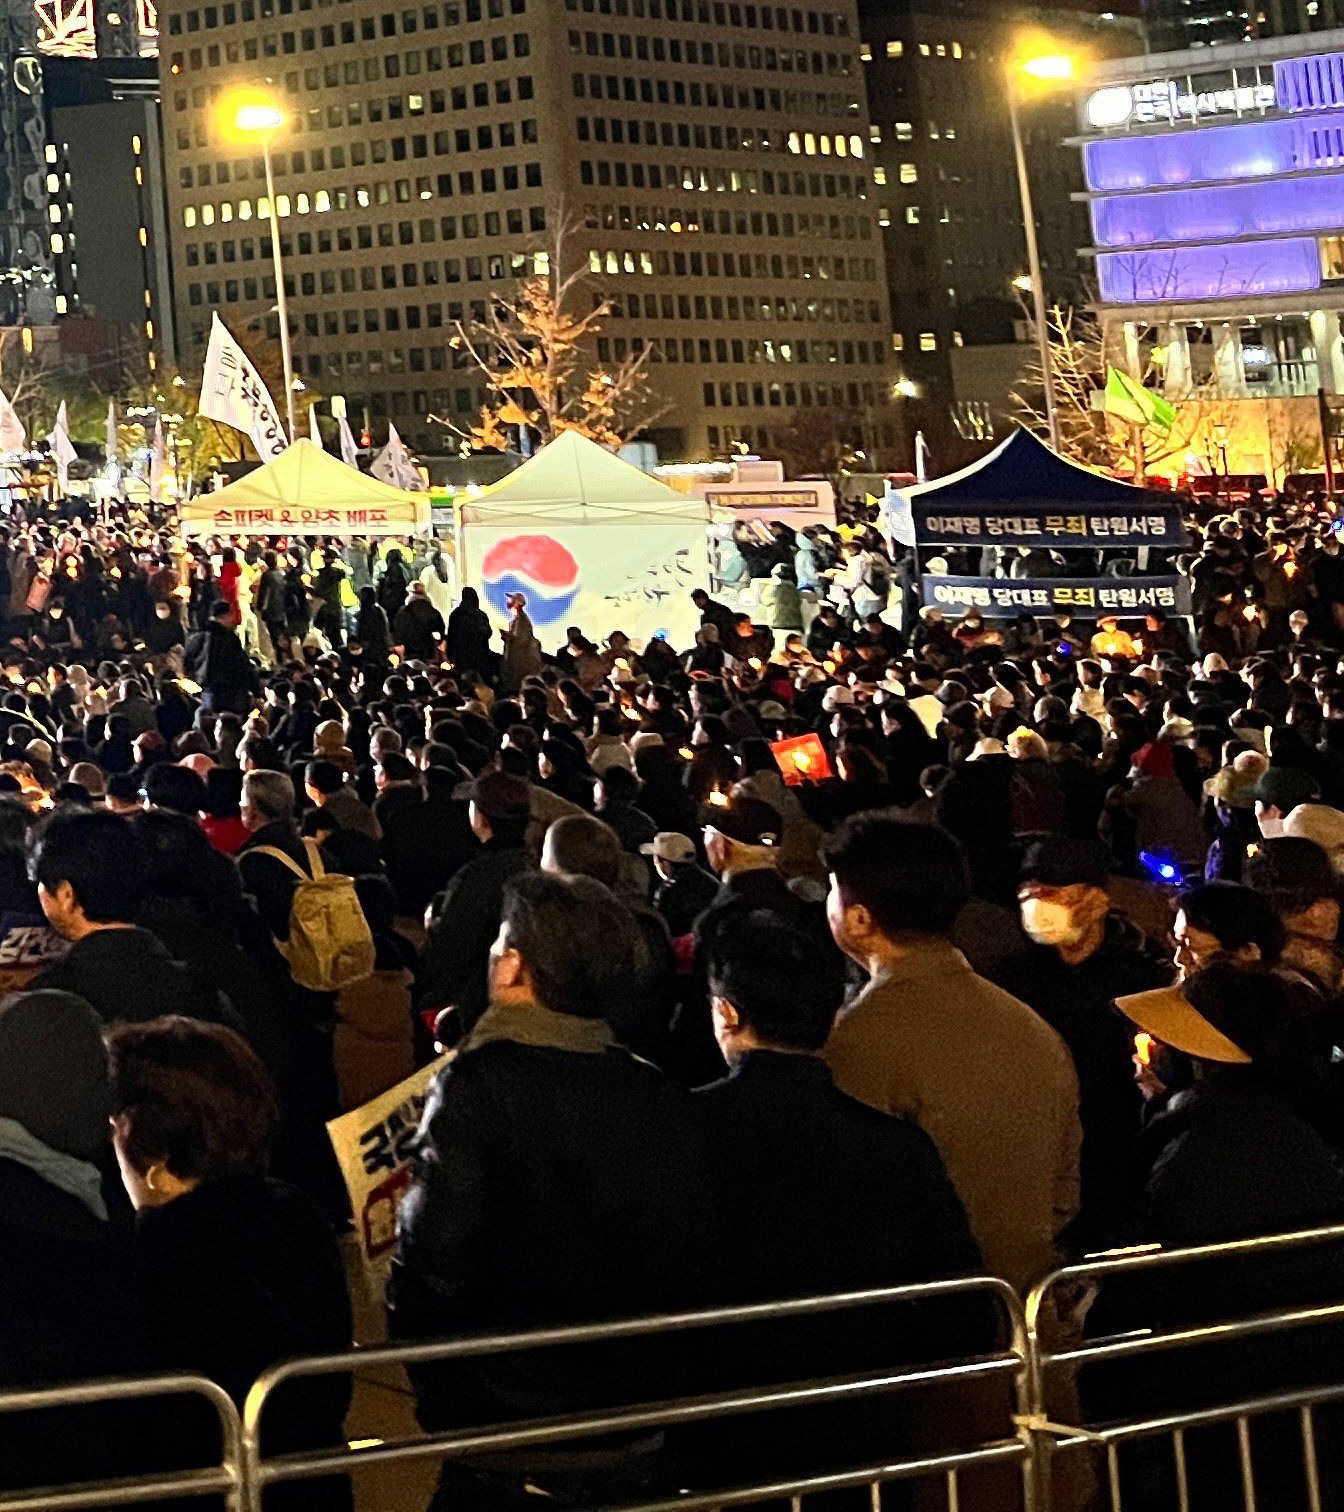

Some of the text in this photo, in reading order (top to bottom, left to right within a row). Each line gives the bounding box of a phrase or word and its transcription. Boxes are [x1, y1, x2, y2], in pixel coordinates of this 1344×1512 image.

[347, 509, 389, 528] 배포
[1044, 515, 1088, 536] 무죄
[1090, 516, 1167, 536] 탄원서명
[1098, 587, 1175, 608] 탄원서명
